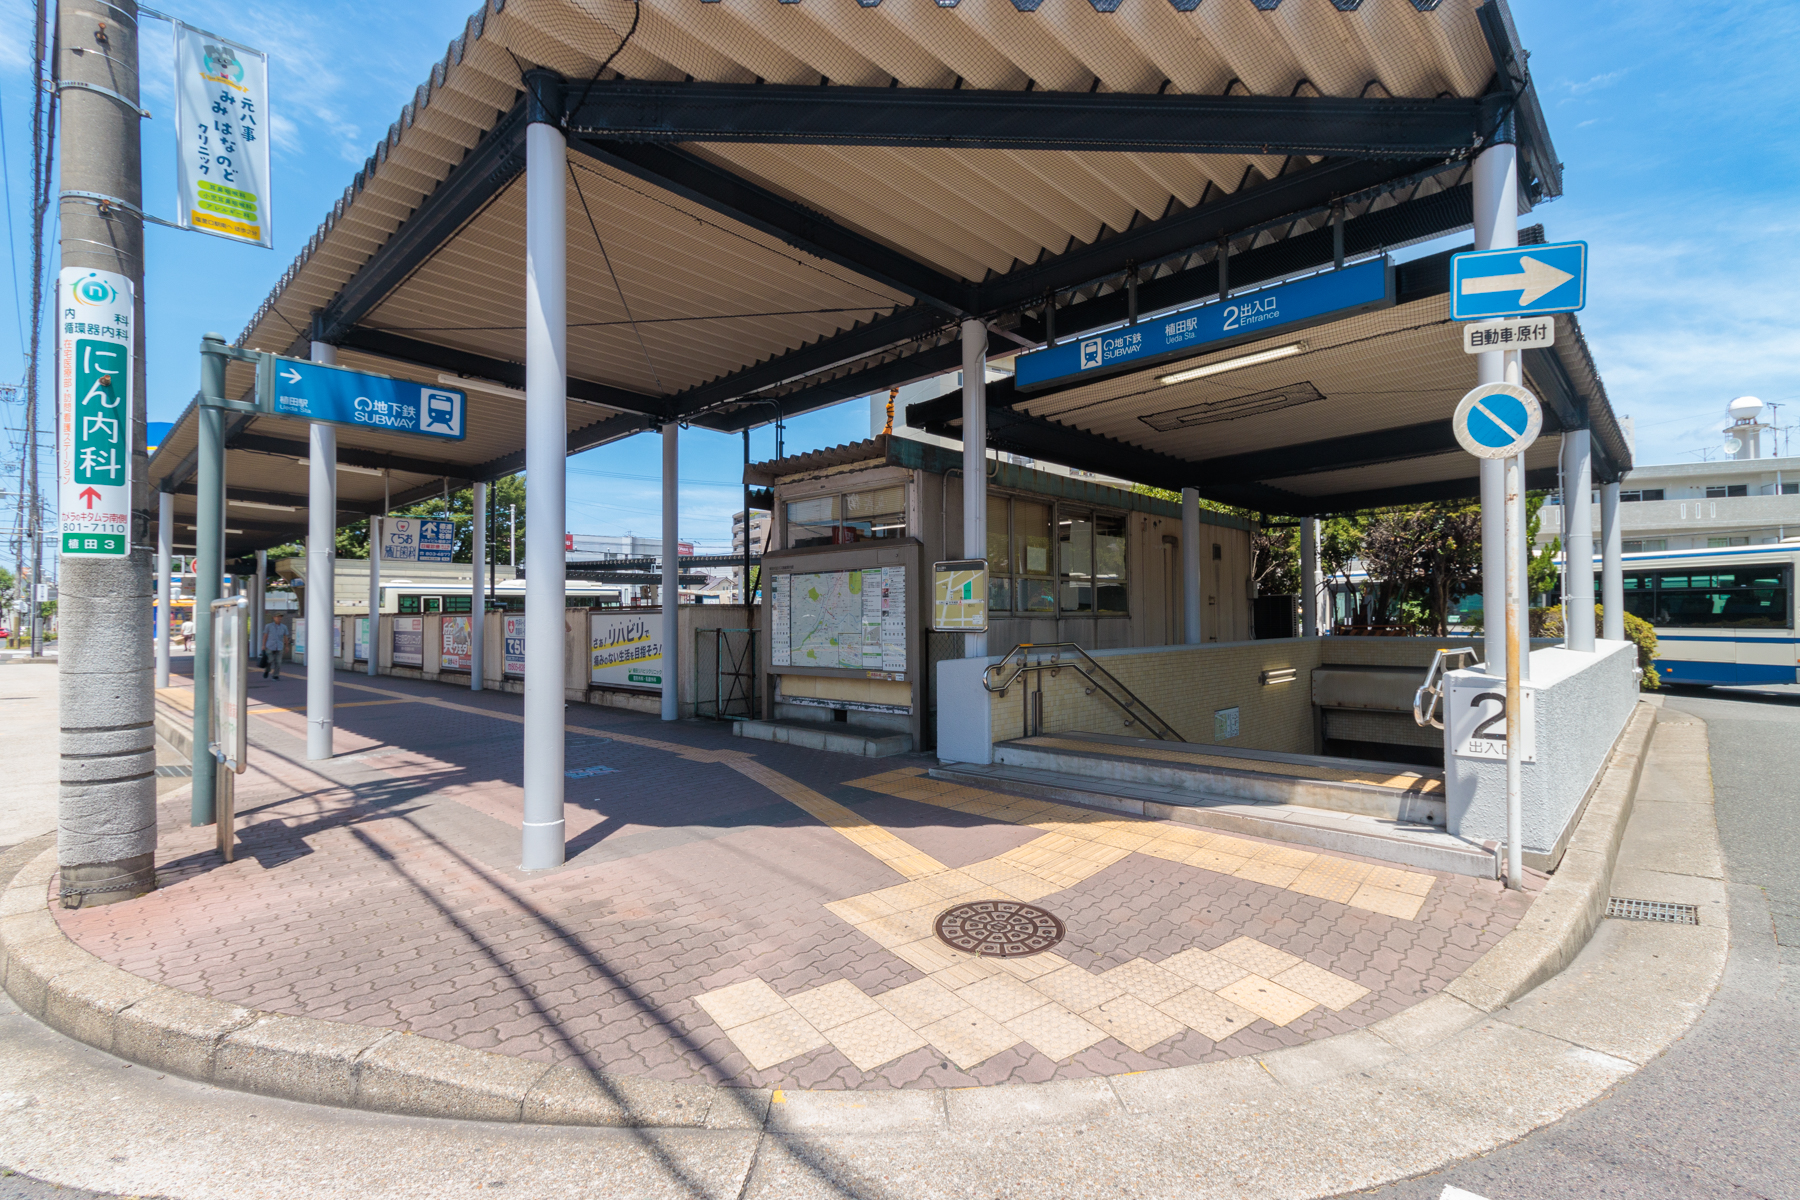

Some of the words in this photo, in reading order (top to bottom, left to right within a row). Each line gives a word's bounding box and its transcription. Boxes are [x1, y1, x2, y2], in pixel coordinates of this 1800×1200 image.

[239, 96, 257, 142] 元八事
[211, 90, 239, 183] みみはなのど
[198, 123, 210, 175] クリニック
[1240, 296, 1277, 318] 出入口
[1165, 316, 1198, 337] 植田駅
[1223, 305, 1239, 331] 2
[1240, 310, 1280, 326] Entrance
[64, 322, 129, 341] 循環器内科
[1114, 332, 1143, 349] 地下鉄
[1166, 333, 1183, 345] Ueda
[1103, 343, 1142, 360] SUBWAY
[279, 395, 308, 408] 植田駅
[279, 404, 298, 412] Ueda
[373, 400, 416, 419] 地下鉄
[79, 345, 121, 479] にん内科
[354, 411, 416, 429] SUBWAY
[62, 523, 125, 533] 801-7110
[390, 533, 413, 544] てらお
[1470, 692, 1507, 741] 2
